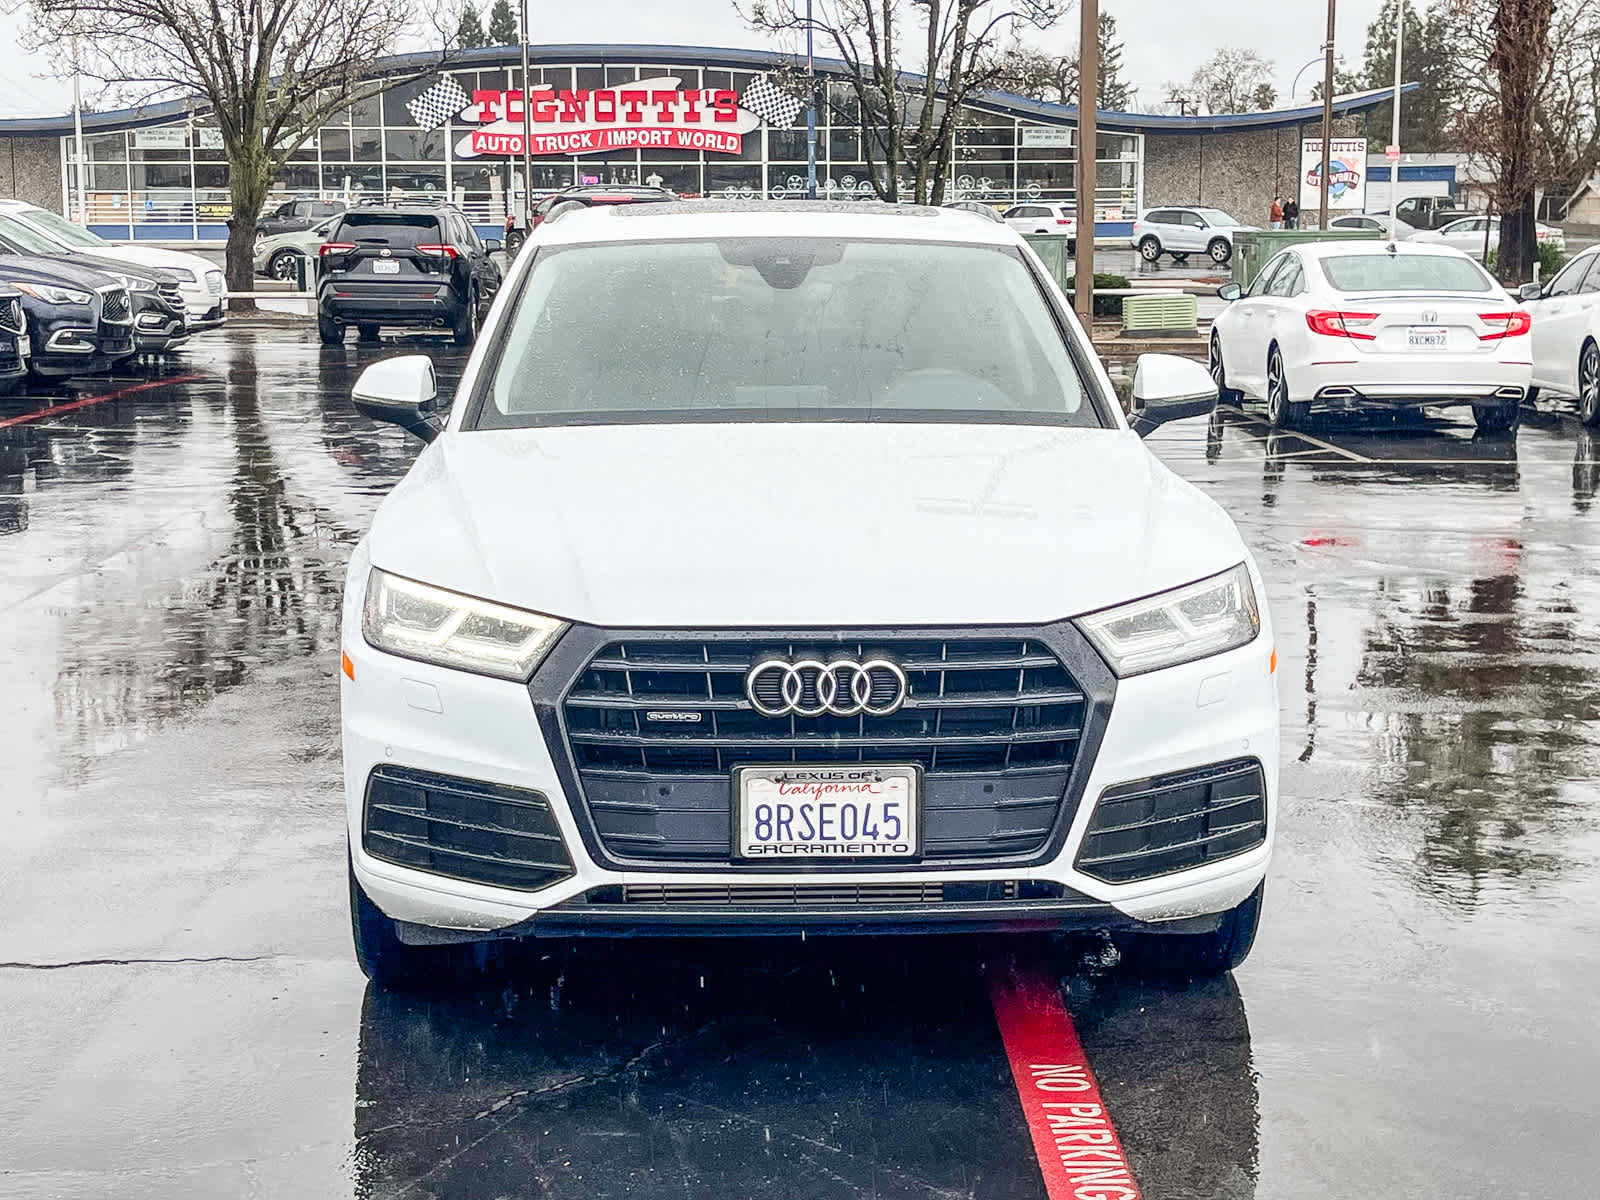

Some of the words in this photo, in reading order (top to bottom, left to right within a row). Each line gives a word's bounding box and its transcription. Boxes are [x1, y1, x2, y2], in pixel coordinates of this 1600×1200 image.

[473, 90, 738, 122] TOGNOTTI'S
[476, 134, 523, 152] AUTO
[536, 133, 594, 151] TRUCK
[607, 130, 674, 146] IMPORT
[677, 131, 738, 151] WORLD
[649, 712, 699, 721] quattro
[783, 771, 844, 780] LEXUS
[848, 771, 874, 780] OF
[778, 782, 881, 800] California
[755, 803, 901, 841] 8RSE045
[748, 843, 909, 855] SACRAMENTO
[1028, 1064, 1092, 1092] NO
